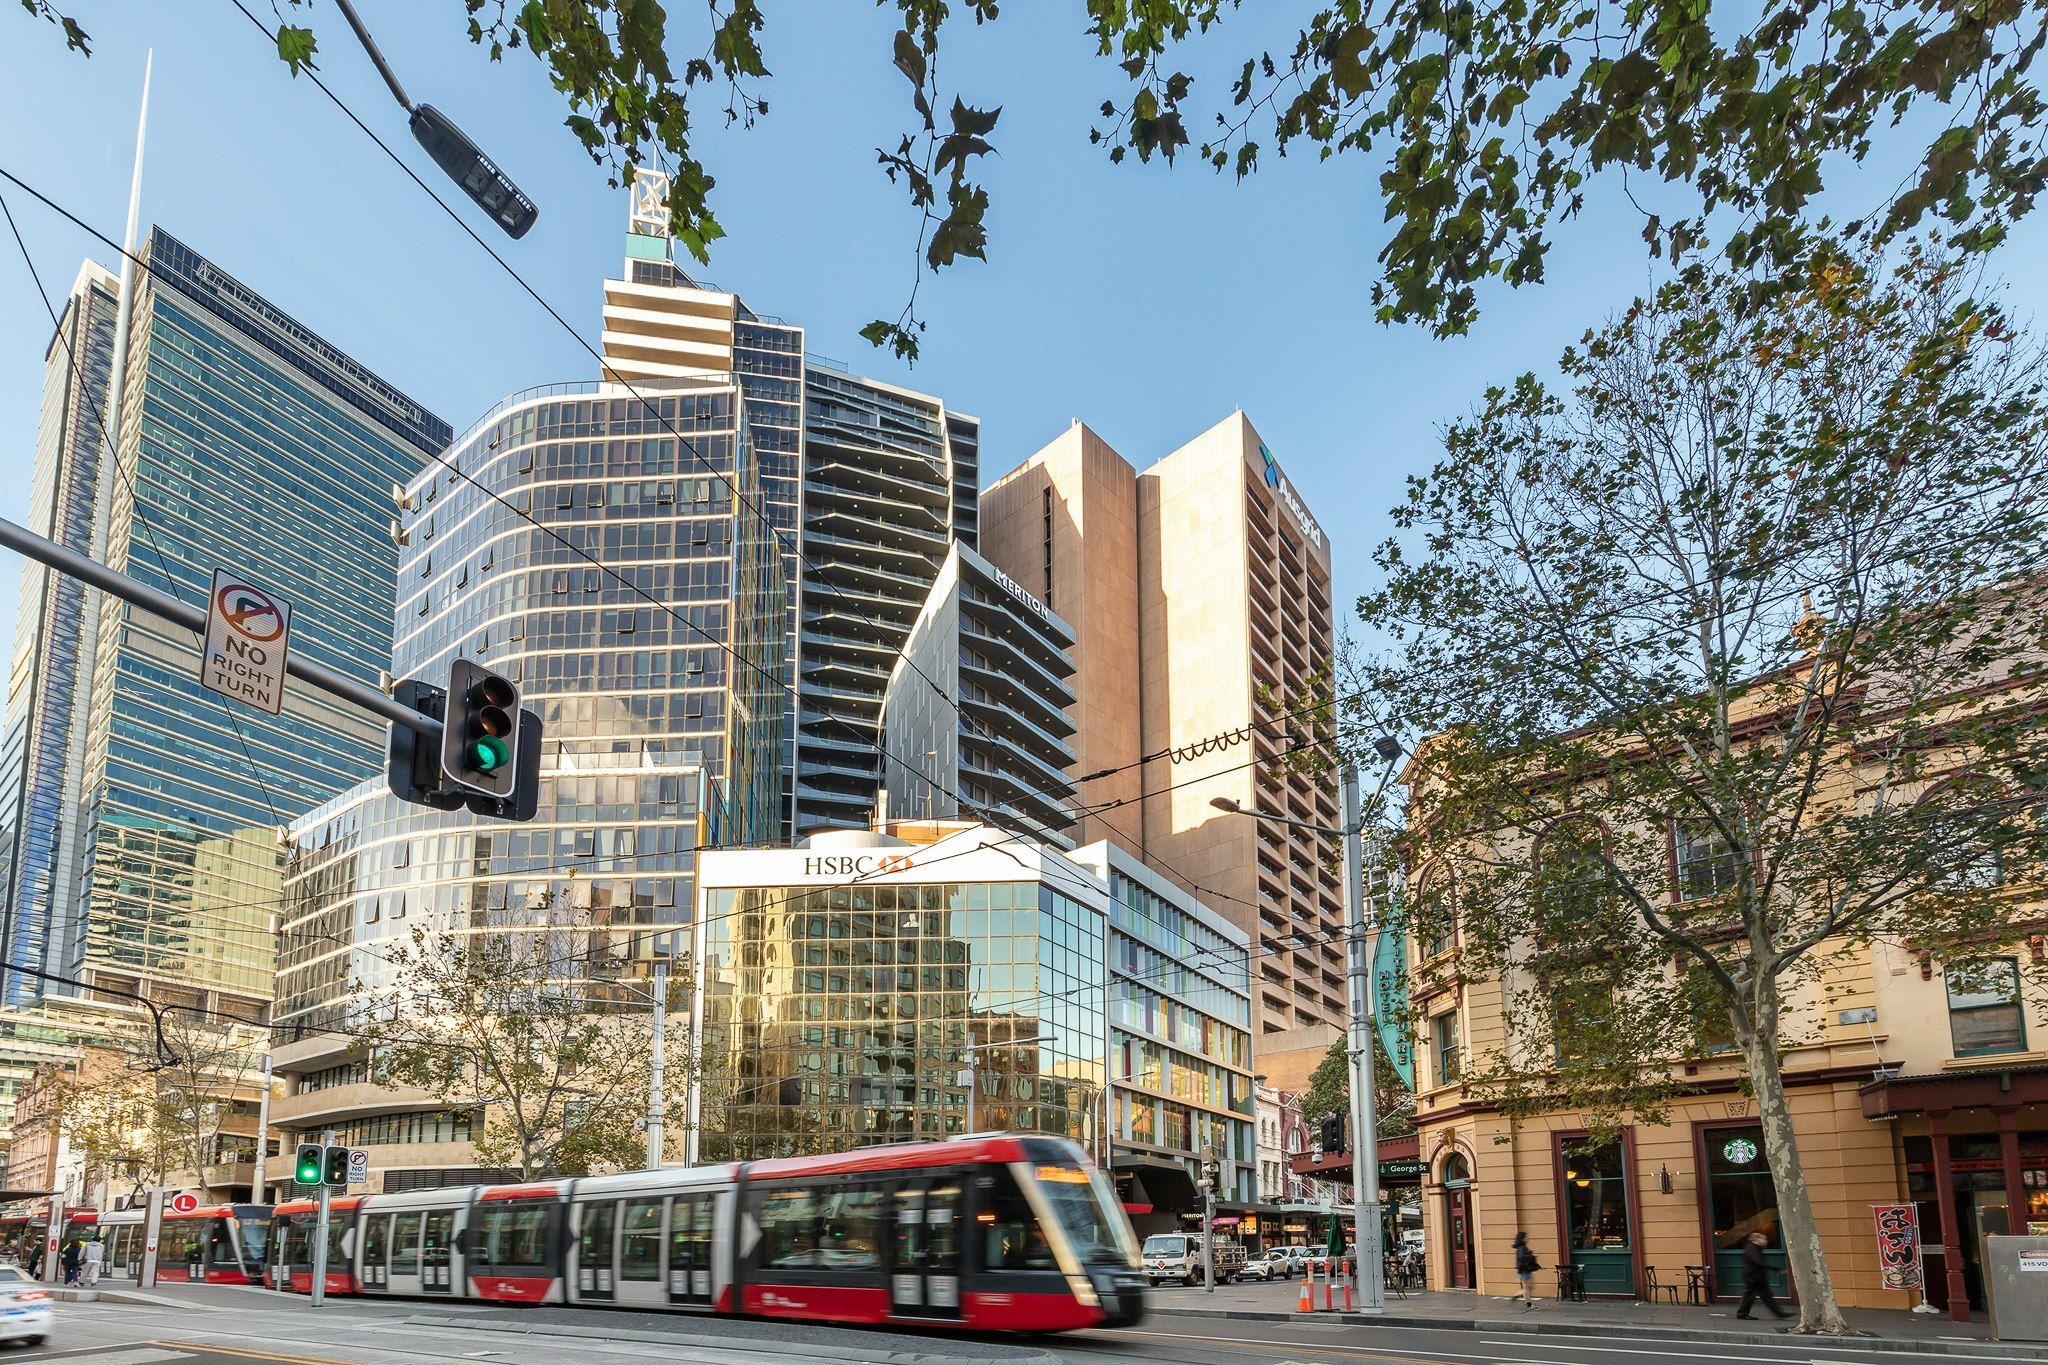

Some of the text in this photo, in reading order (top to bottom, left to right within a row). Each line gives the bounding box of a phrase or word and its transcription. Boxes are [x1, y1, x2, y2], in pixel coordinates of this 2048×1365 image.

[1278, 477, 1321, 550] Ausgrid
[994, 567, 1049, 620] MERITON
[225, 634, 267, 666] NO
[213, 653, 275, 687] RIGHT
[215, 671, 270, 705] TURN
[803, 855, 874, 876] HSBC
[1379, 970, 1390, 1022] HOTEL
[1390, 1165, 1417, 1173] George
[181, 1197, 190, 1209] L
